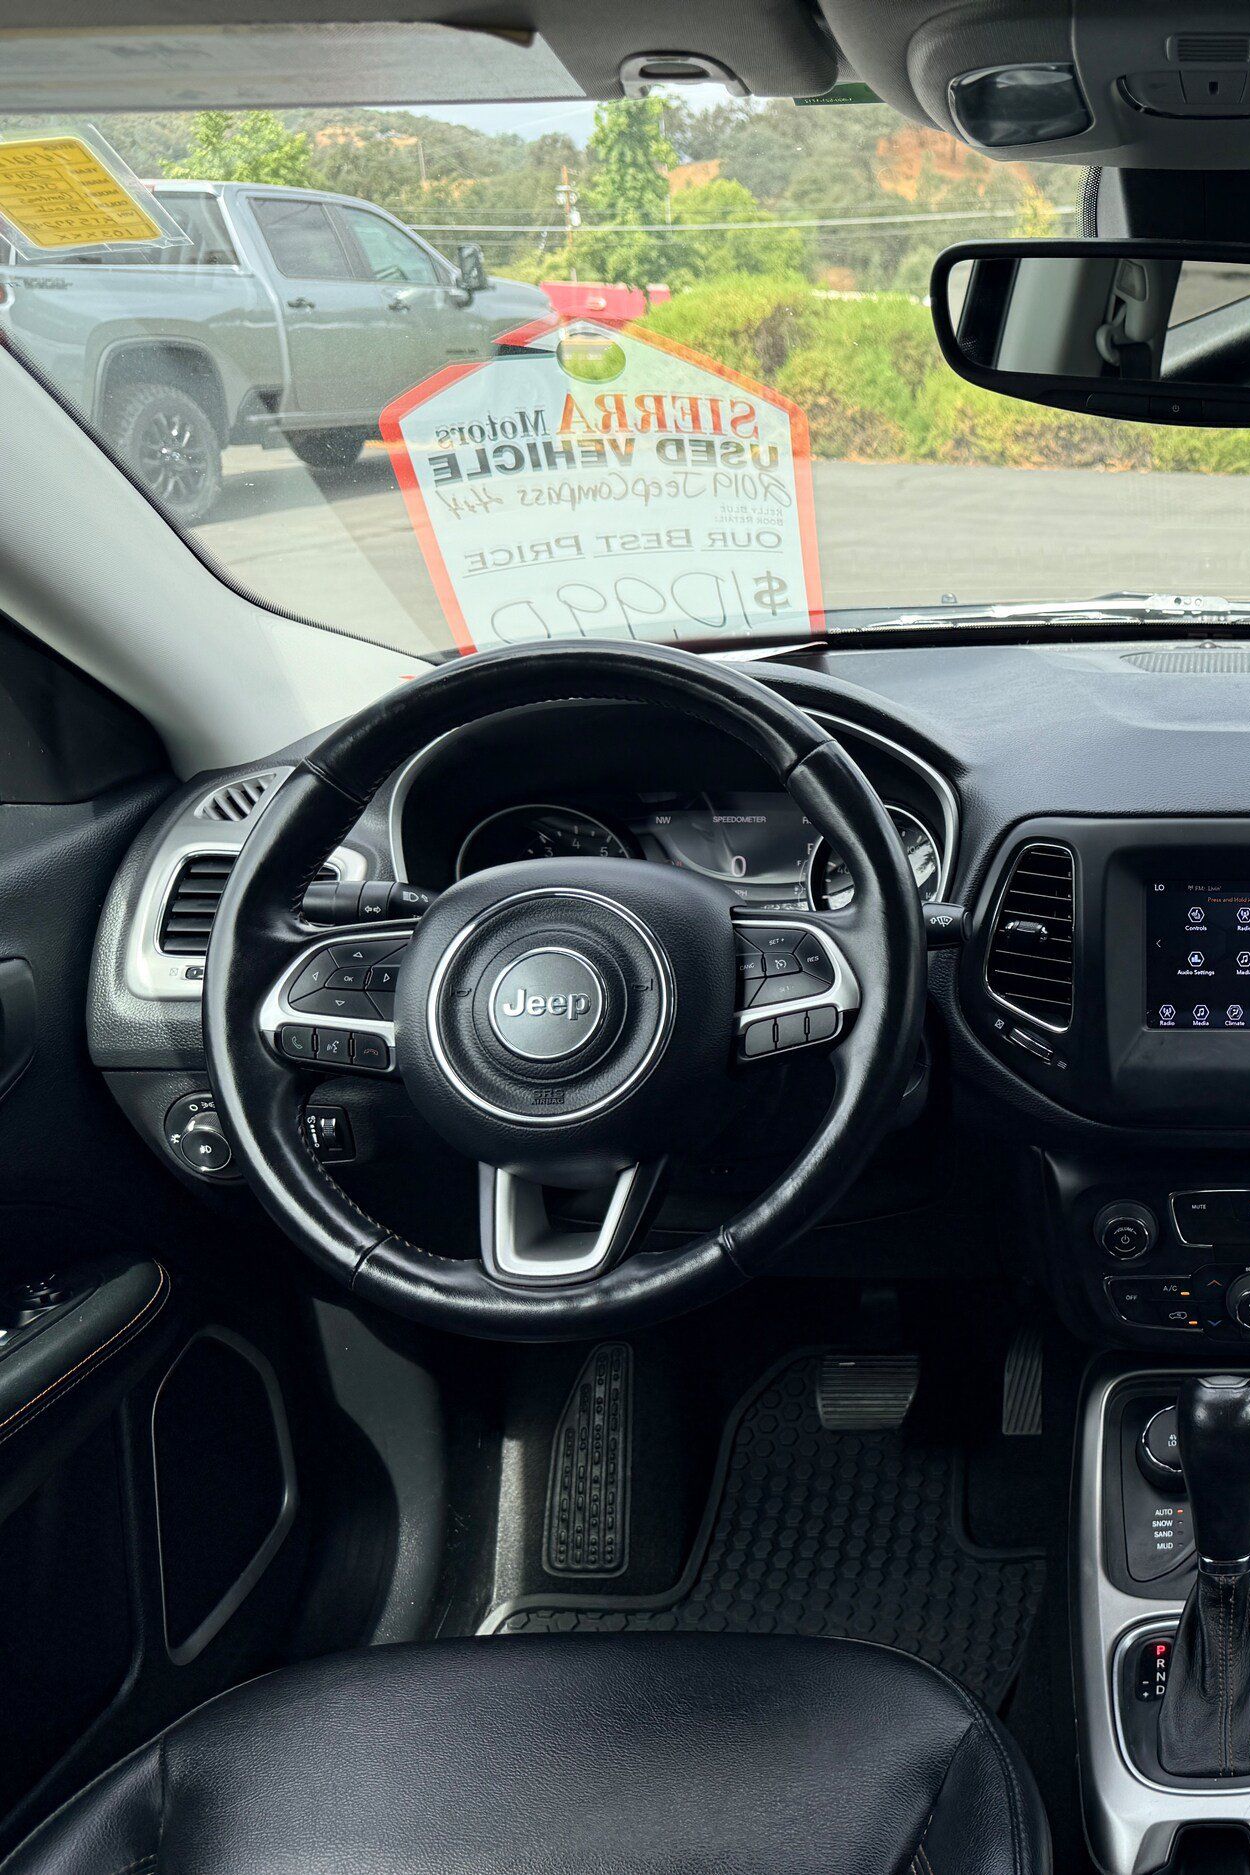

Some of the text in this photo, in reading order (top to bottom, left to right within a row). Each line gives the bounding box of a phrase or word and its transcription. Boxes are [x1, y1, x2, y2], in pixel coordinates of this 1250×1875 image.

[655, 816, 671, 824] NW
[712, 815, 767, 824] SPEEDOMETER
[572, 838, 581, 850] 4
[600, 846, 609, 857] 5
[731, 855, 747, 878] 0
[1154, 884, 1165, 892] LO
[1194, 969, 1215, 977] Settings
[503, 988, 592, 1020] Jeep
[1163, 1284, 1177, 1292] A/C
[1155, 1508, 1173, 1516] AUTO
[1154, 1530, 1173, 1538] SAND
[1156, 1645, 1166, 1655] P
[1156, 1658, 1165, 1668] R
[1156, 1671, 1166, 1682] N
[1156, 1685, 1165, 1695] D
